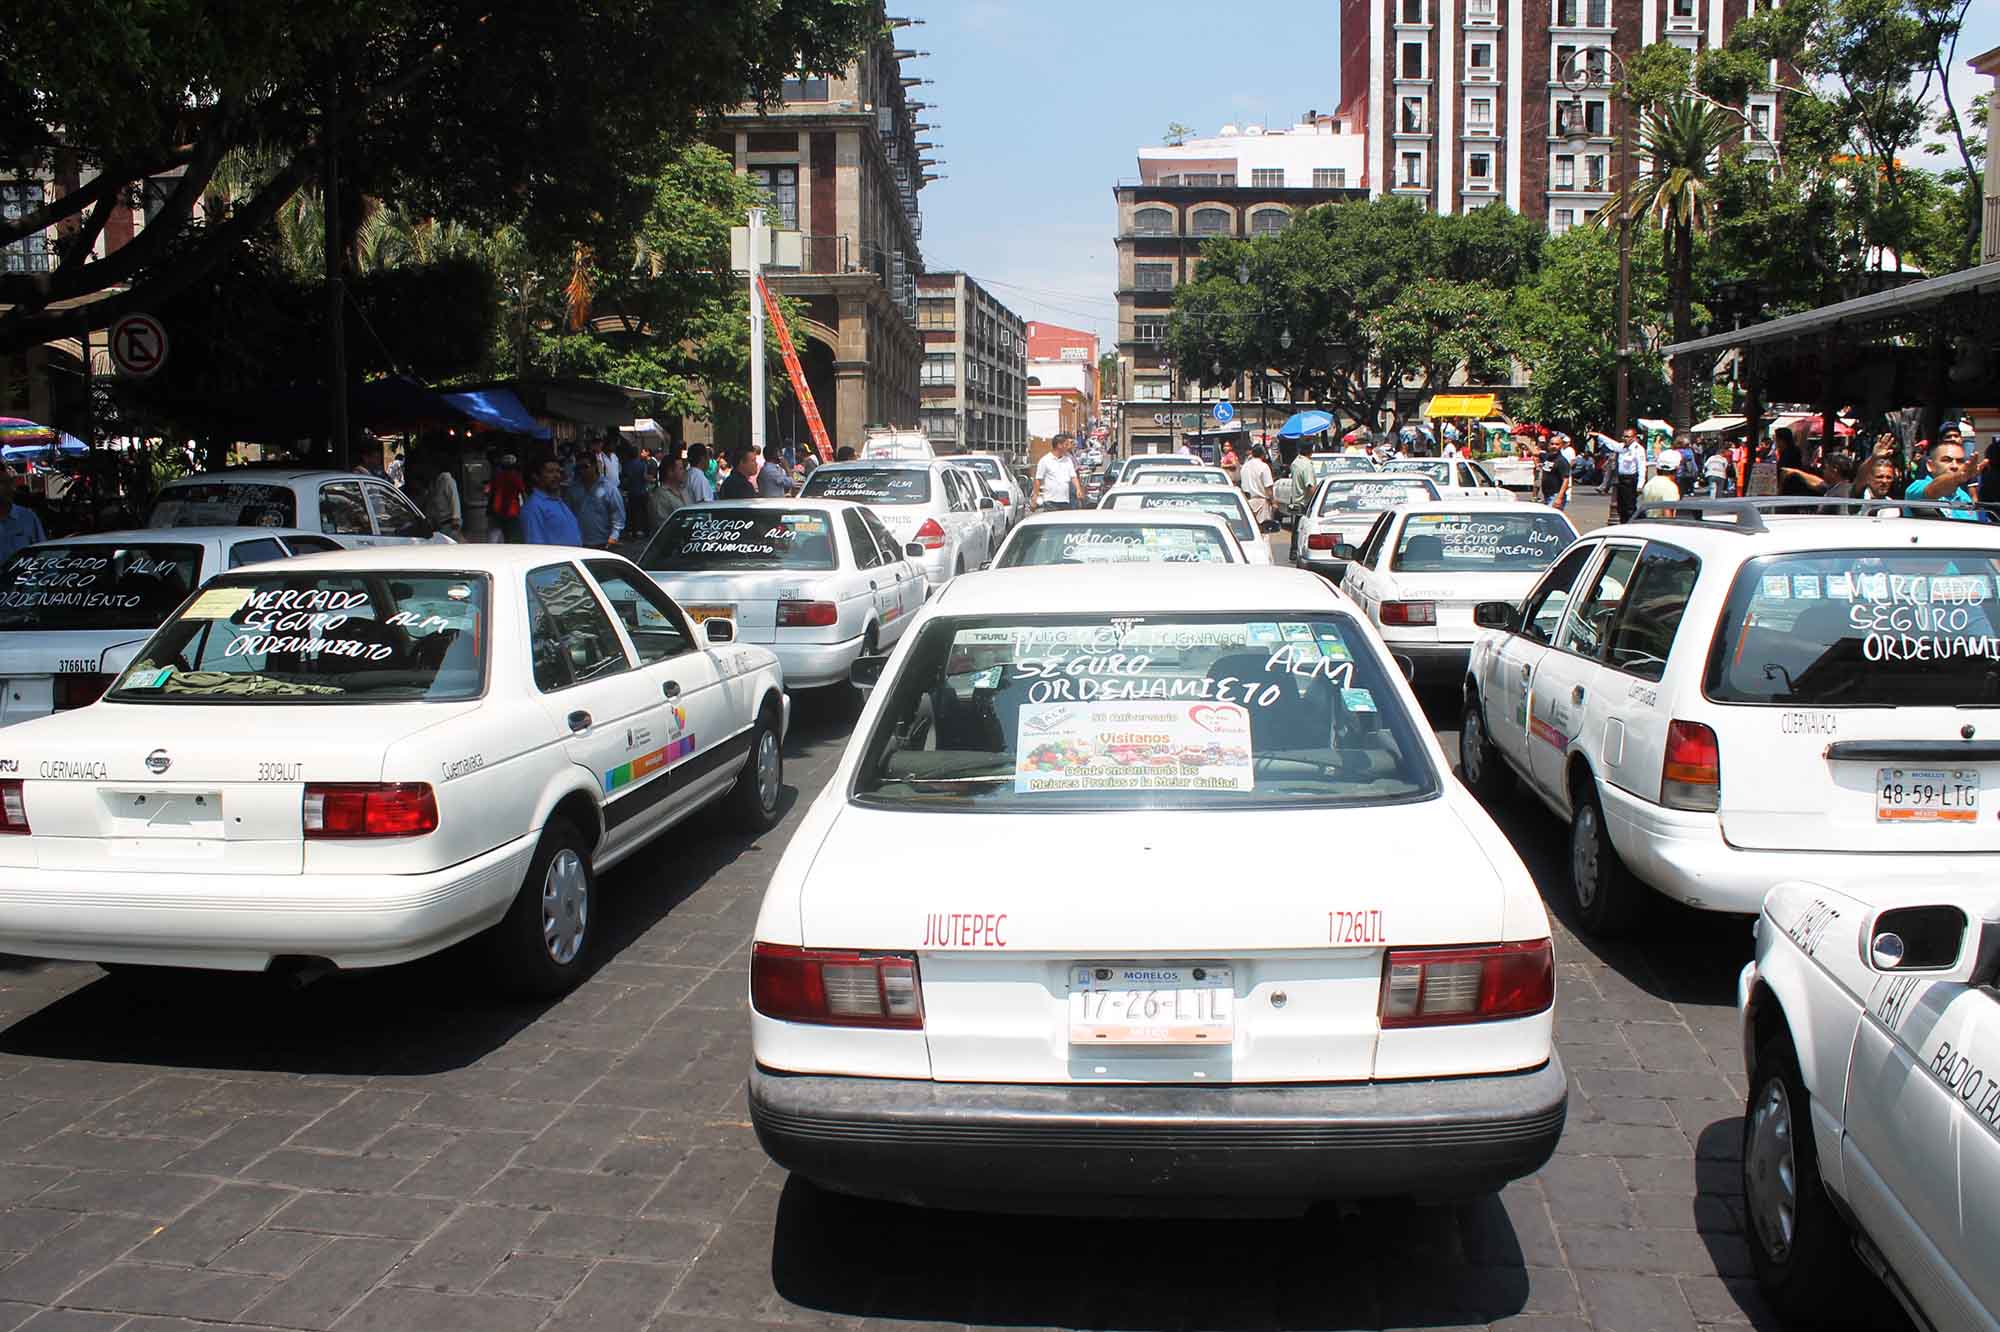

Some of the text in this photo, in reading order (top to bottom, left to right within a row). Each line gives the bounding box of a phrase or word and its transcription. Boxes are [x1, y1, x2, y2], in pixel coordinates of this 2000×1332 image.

[692, 519, 754, 530] MERCADO
[1439, 522, 1505, 534] MERCADO
[690, 530, 741, 540] SEGURO
[764, 528, 798, 541] ALM
[1443, 534, 1499, 545] SEGURO
[1528, 530, 1559, 546] ALM
[682, 542, 774, 554] ORDENAMIENTO
[1442, 545, 1544, 557] ORDENAMIENTO
[9, 557, 108, 571] MERCADO
[125, 557, 177, 575] ALM
[14, 571, 97, 587] SEGURO
[1844, 571, 1987, 607] MERCADO
[239, 589, 369, 611] MERCADO
[240, 610, 348, 632] SEGURO
[386, 611, 449, 633] ALM
[1849, 605, 1968, 633] SEGURO
[225, 634, 392, 661] ORDENAMIENTO
[58, 659, 96, 672] 3766LTG
[1012, 654, 1151, 680] SEGURO
[1264, 644, 1354, 691] ALM
[1781, 712, 1838, 735] CUERNAVACA
[1100, 732, 1171, 744] Visitanos
[40, 760, 107, 779] CUERNAVACA
[257, 762, 304, 781] 3309LUT
[1882, 784, 1975, 806] 48-59-LTG
[923, 913, 1007, 947] JIUTEPEC
[1328, 909, 1386, 943] 1726LTL
[1123, 971, 1179, 980] MORELOS
[1081, 989, 1226, 1020] 17-26-LTL
[1930, 1041, 1983, 1100] RADIO
